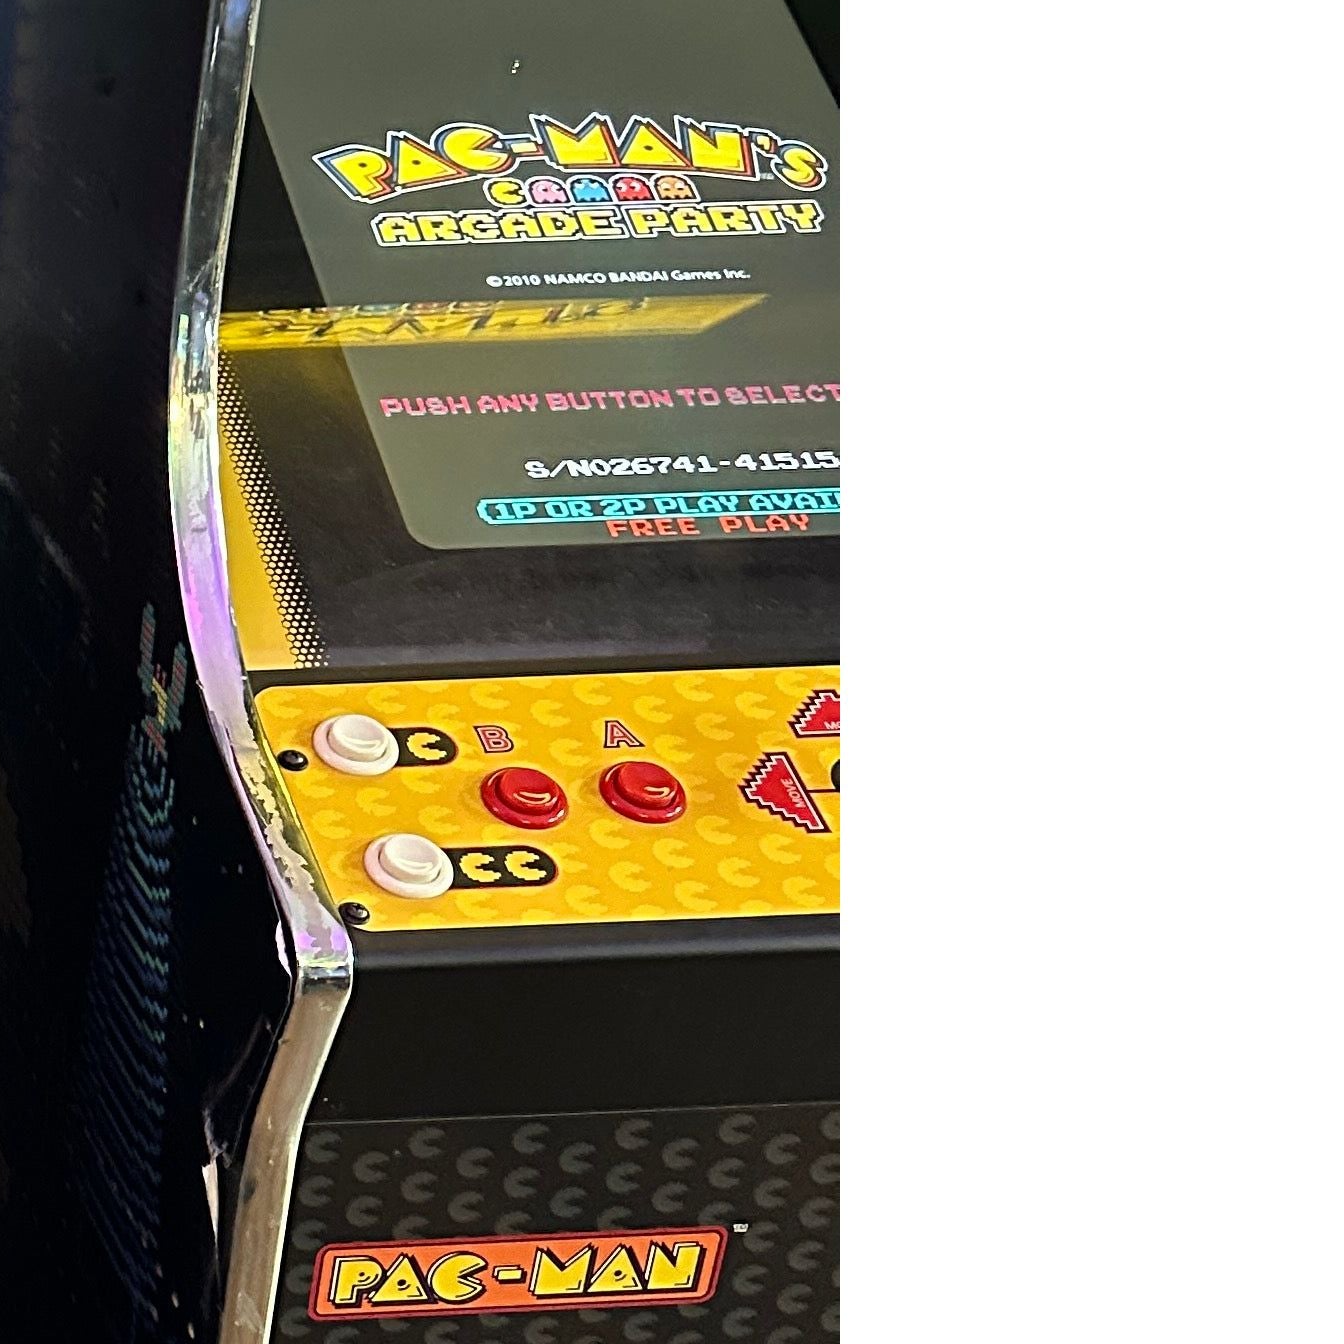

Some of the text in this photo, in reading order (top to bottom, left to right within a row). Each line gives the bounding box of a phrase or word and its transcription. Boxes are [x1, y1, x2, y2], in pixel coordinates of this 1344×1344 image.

[314, 111, 830, 204] PAC-MAN'S
[374, 199, 827, 248] ARCADE PARTY
[543, 272, 607, 286] NAMCO
[608, 270, 669, 284] BANDAI
[670, 268, 721, 282] Games
[723, 267, 751, 280] Inc.
[379, 395, 472, 417] PUSH
[476, 392, 539, 415] ANY
[545, 389, 674, 413] BUTTON
[676, 386, 719, 408] TO
[544, 499, 595, 518] OR
[600, 497, 650, 517] 2P
[657, 493, 740, 515] PLAY
[606, 513, 811, 538] FREE PLAY
[473, 725, 514, 754] B
[602, 720, 646, 749] A
[781, 778, 806, 808] MOVE
[328, 1241, 705, 1306] PAC-MAN
